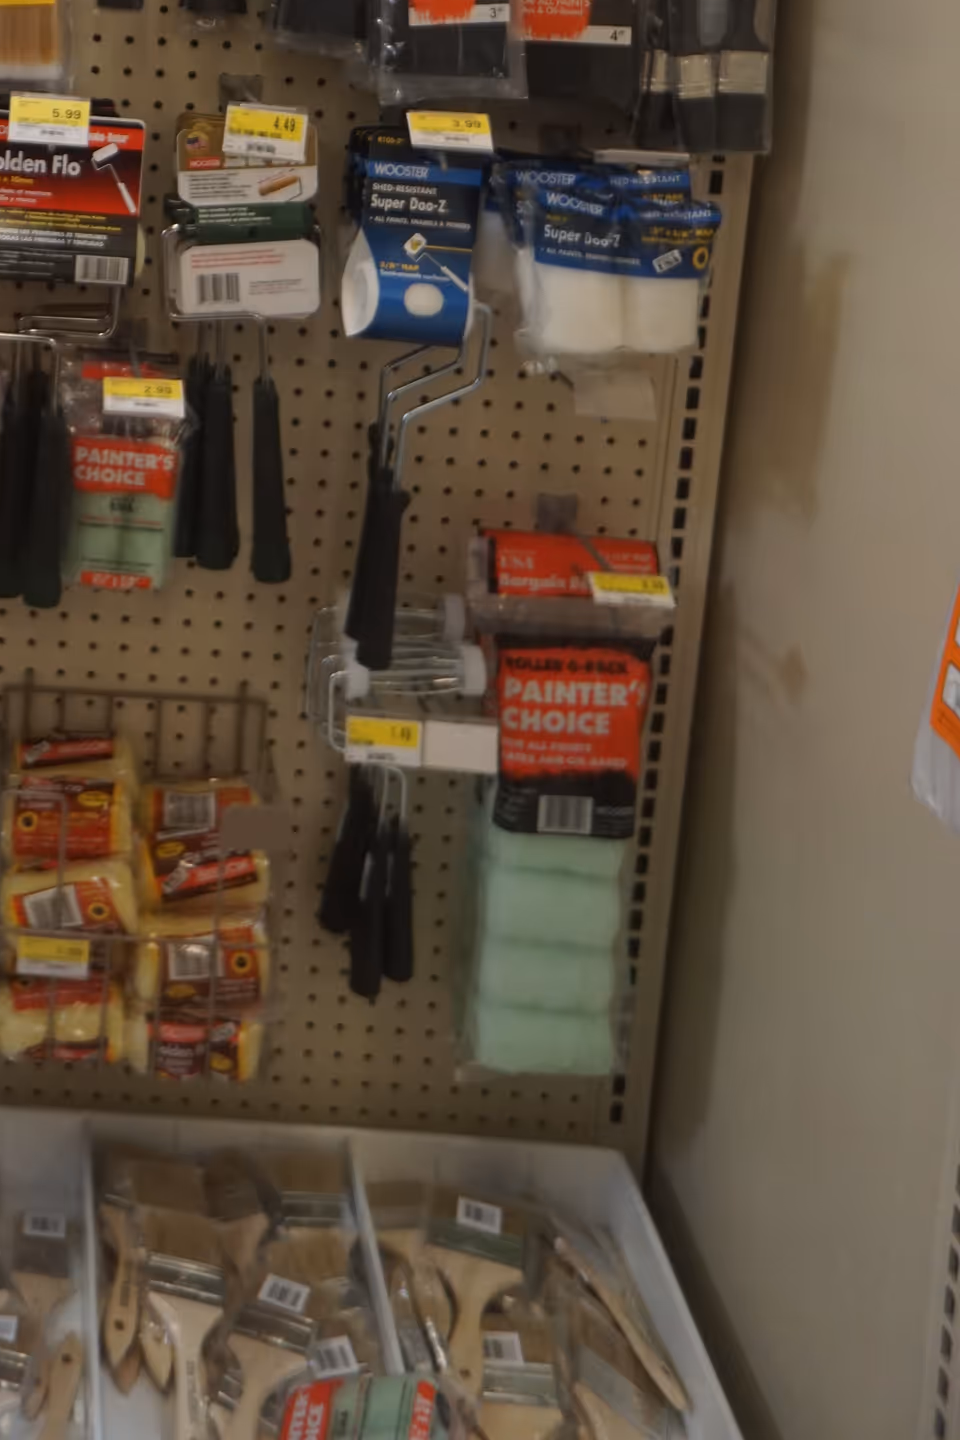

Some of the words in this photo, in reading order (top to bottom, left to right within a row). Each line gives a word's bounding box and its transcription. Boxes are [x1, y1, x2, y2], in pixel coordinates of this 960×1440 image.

[52, 108, 82, 120] 5.99
[52, 153, 82, 176] Flo
[374, 163, 430, 178] WOOSTER
[372, 182, 438, 195] SHED-RESISTANT
[515, 170, 577, 185] WOOSTER
[370, 194, 406, 211] Super
[409, 197, 447, 213] Doo-Z
[545, 192, 605, 216] WOOSTER
[543, 224, 582, 245] Super
[584, 230, 621, 248] Doo-Z
[74, 446, 176, 471] PAINTER'S
[74, 464, 146, 487] CHOICE
[502, 707, 610, 736] CHOICE
